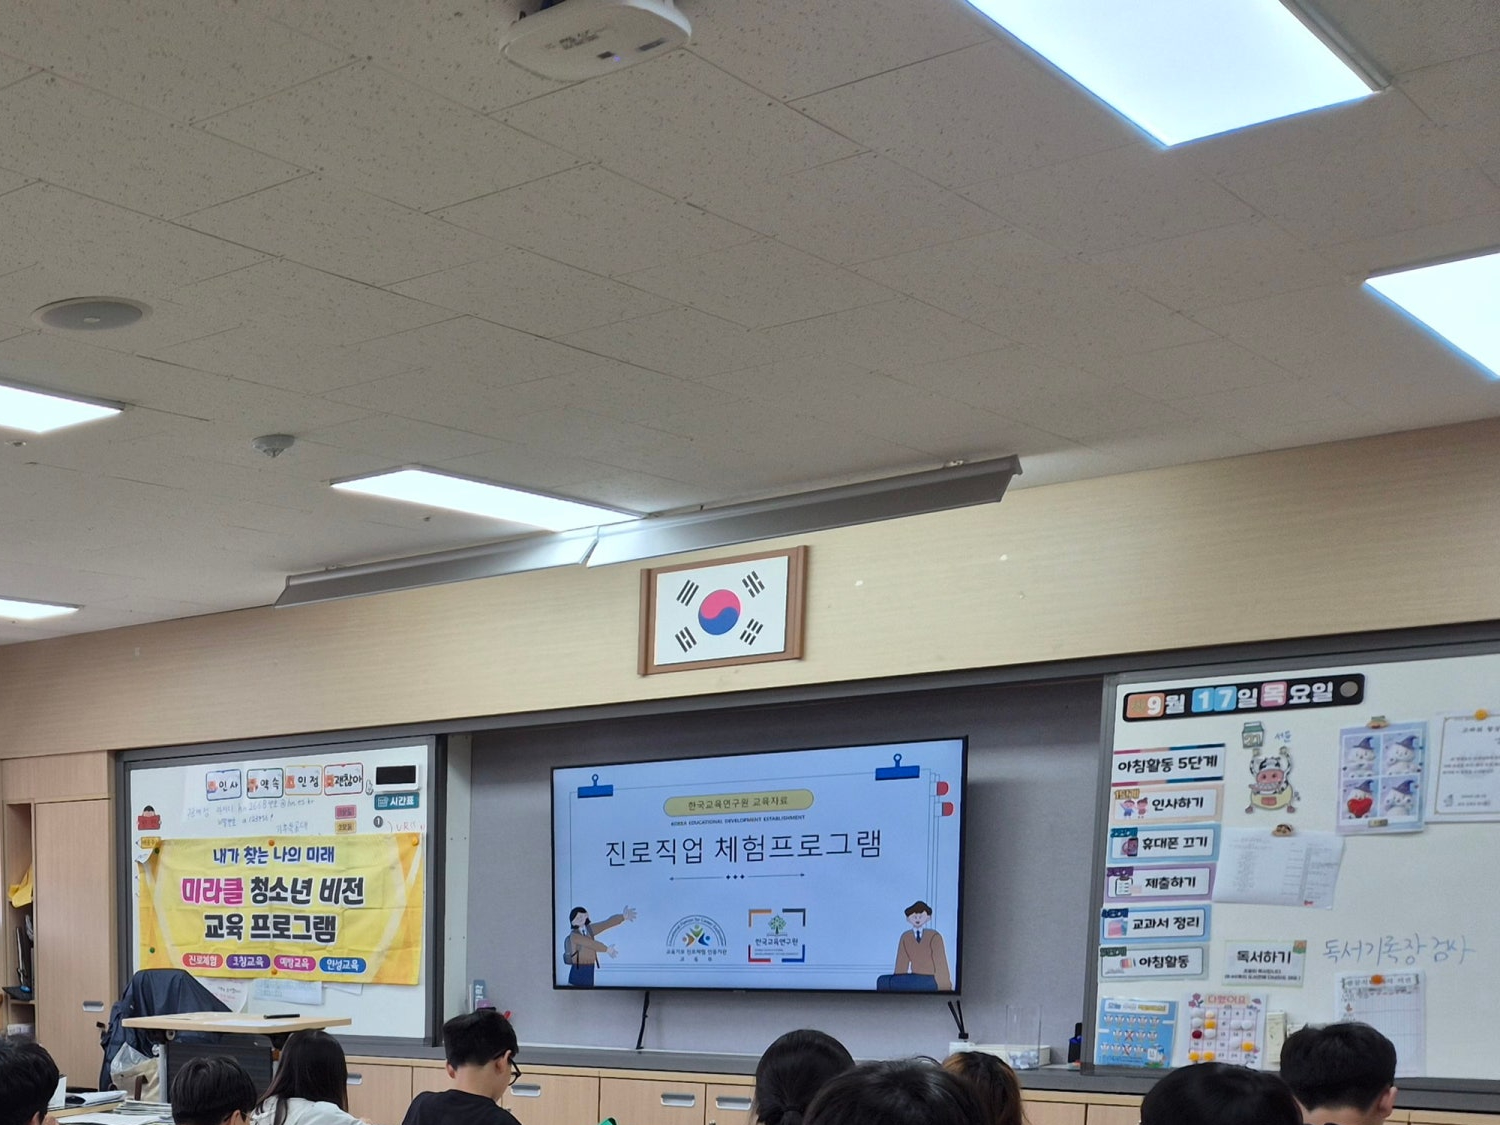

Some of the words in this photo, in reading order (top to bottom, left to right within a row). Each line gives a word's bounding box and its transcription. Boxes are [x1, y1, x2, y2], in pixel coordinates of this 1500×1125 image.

[1146, 694, 1186, 715] 9월
[1198, 688, 1258, 710] 17일
[1263, 682, 1333, 706] 목요일
[1118, 757, 1173, 773] 아침활동
[1178, 755, 1218, 770] 5단계
[218, 780, 238, 792] 인사
[260, 777, 279, 791] 약속
[389, 795, 414, 807] 시간표
[688, 797, 749, 811] 한국교육연구원
[752, 796, 788, 808] 교육자료
[1152, 797, 1203, 811] 인사하기
[605, 837, 703, 867] 진로직업
[715, 829, 882, 863] 체험프로그램
[1142, 837, 1179, 850] 휴대폰
[1183, 836, 1208, 848] 끄기
[213, 847, 239, 864] 내가
[244, 846, 269, 865] 찾는
[273, 846, 301, 863] 나의
[306, 846, 335, 864] 미래
[1145, 876, 1197, 890] 제출하기
[182, 878, 243, 905] 미라클
[250, 876, 313, 905] 청소년
[319, 877, 364, 905] 비전
[204, 913, 243, 941] 교육
[250, 914, 336, 943] 프로그램
[1133, 918, 1169, 930] 교과서
[1173, 916, 1199, 930] 정리
[1323, 933, 1426, 966] 독서기록장
[188, 954, 218, 966] 진로체험
[326, 959, 358, 971] 인성교육
[1139, 955, 1189, 969] 아침활동
[1237, 951, 1291, 964] 독서하기
